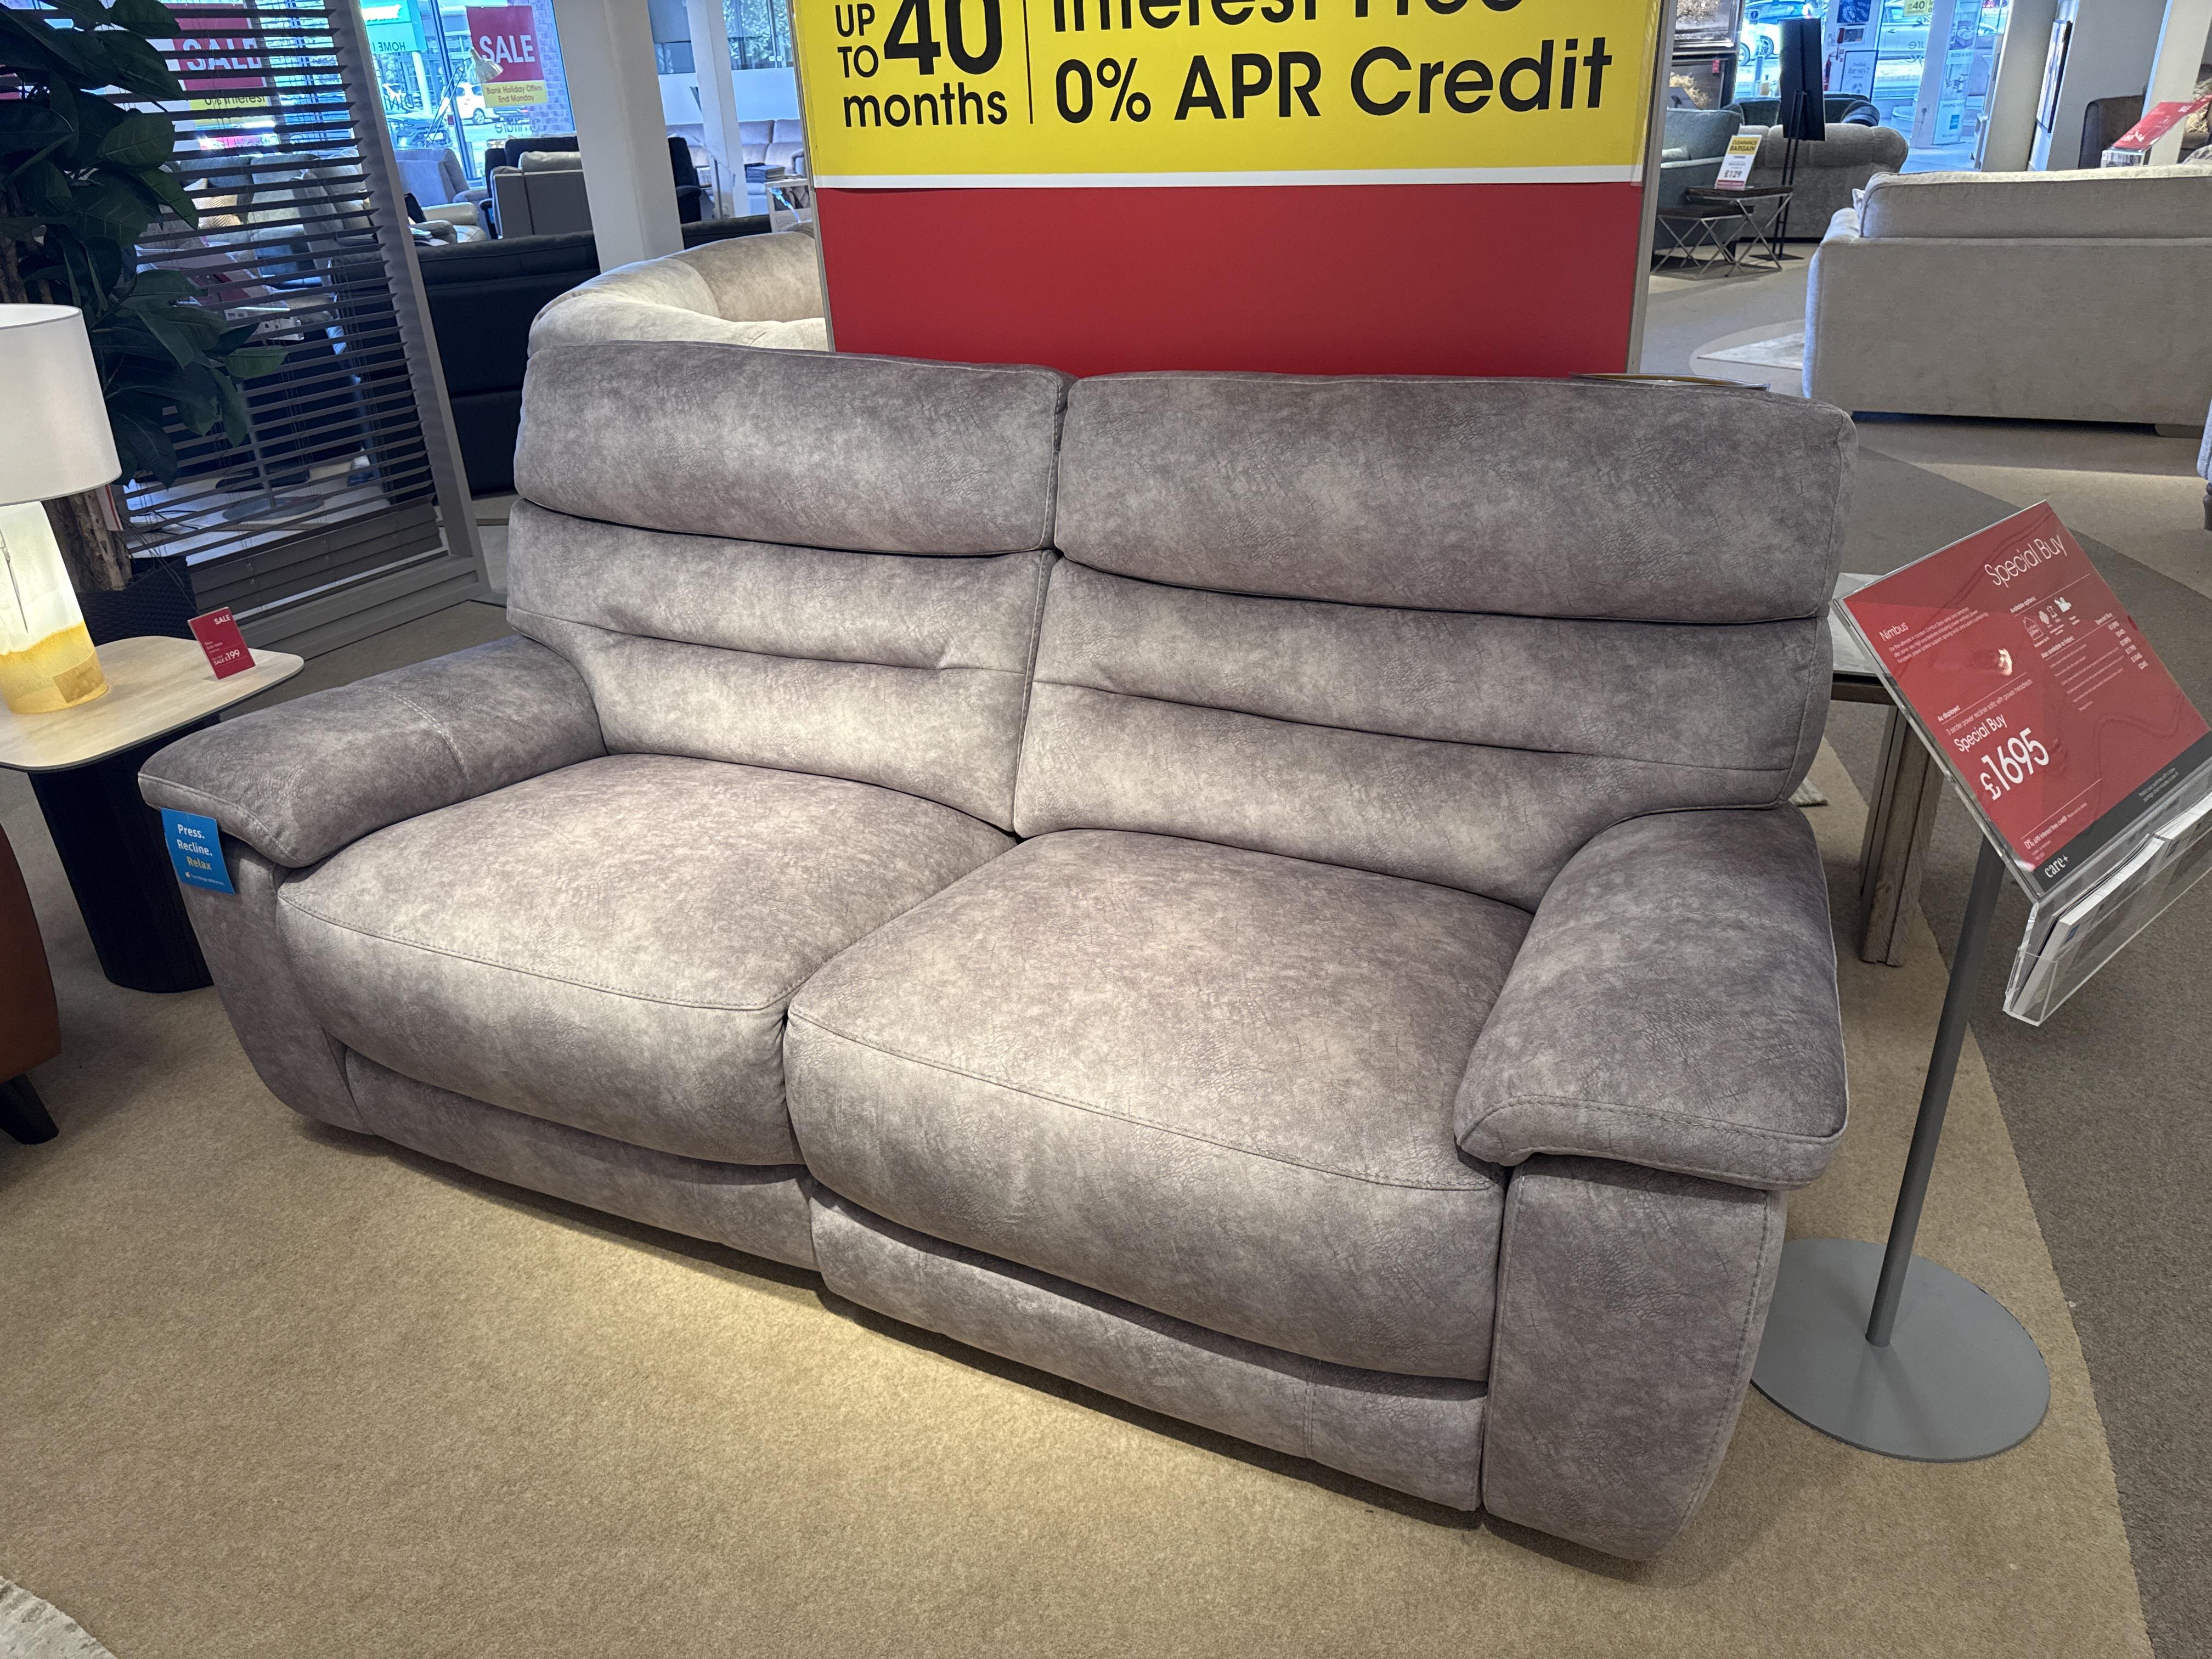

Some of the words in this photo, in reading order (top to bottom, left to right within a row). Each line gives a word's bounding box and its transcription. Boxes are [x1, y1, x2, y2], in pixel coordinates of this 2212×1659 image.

[835, 3, 875, 37] UP
[1912, 1, 1925, 9] 40
[479, 35, 535, 64] SALE
[883, 0, 1003, 75] 40
[838, 44, 879, 78] TO
[1056, 58, 1151, 123] 0%
[1174, 51, 1321, 120] APR
[1351, 37, 1612, 116] Credit
[843, 82, 1008, 127] months
[1984, 543, 2042, 588] Special
[2033, 535, 2067, 560] Buy
[214, 614, 232, 625] SALE
[1879, 622, 1909, 641] Nimbus
[225, 649, 240, 662] £199
[1943, 705, 1960, 720] displayed
[1950, 722, 1963, 734] seater
[1962, 716, 1974, 727] power
[1974, 707, 1988, 718] recliner
[1988, 701, 1997, 710] sofa
[1996, 695, 2004, 704] with
[2003, 689, 2015, 701] power
[2014, 679, 2033, 693] headrests
[1954, 722, 1990, 752] Special
[1986, 714, 2007, 731] Buy
[1980, 727, 2049, 800] £1695
[177, 839, 212, 856] Recline.
[178, 824, 205, 839] Press.
[2024, 838, 2035, 849] 0%
[2033, 835, 2041, 843] APR
[2040, 827, 2052, 839] interest
[2057, 815, 2068, 826] credit
